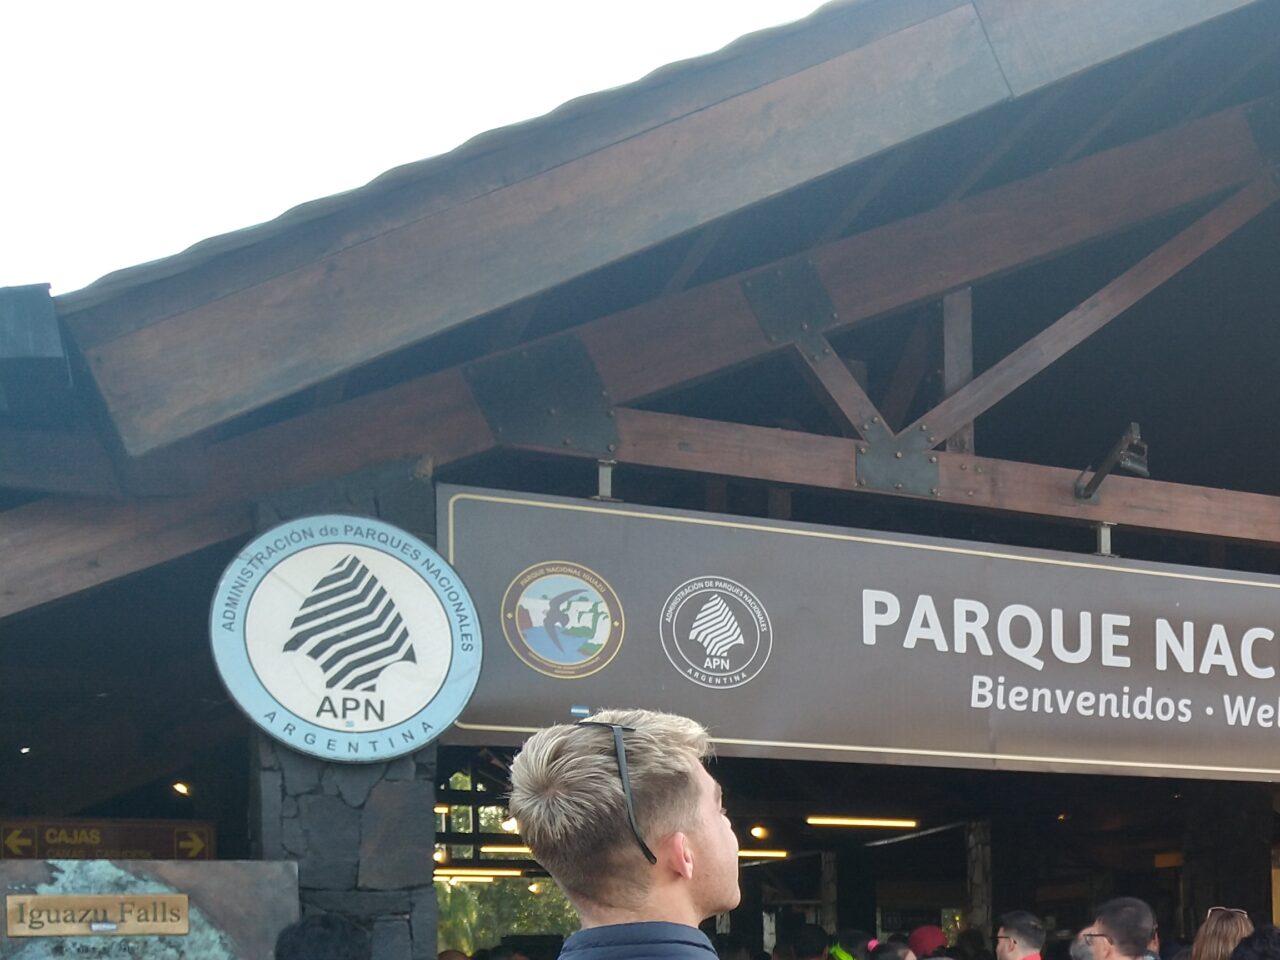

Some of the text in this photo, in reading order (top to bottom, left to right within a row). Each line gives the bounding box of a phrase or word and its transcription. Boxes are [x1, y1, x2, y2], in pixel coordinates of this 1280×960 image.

[222, 525, 474, 652] ADMINISTRACIÓN de PARQUES NACIONALES
[714, 581, 744, 597] PARQUES
[743, 594, 767, 632] NACIONALES
[862, 589, 1131, 671] PARQUE
[686, 667, 748, 684] ARGENTINA
[704, 657, 730, 670] APN
[316, 695, 386, 722] APN
[970, 675, 1193, 723] Bienvenidos
[264, 710, 434, 753] ARGENTINA
[45, 828, 101, 845] CAJAS
[118, 901, 181, 924] Falls
